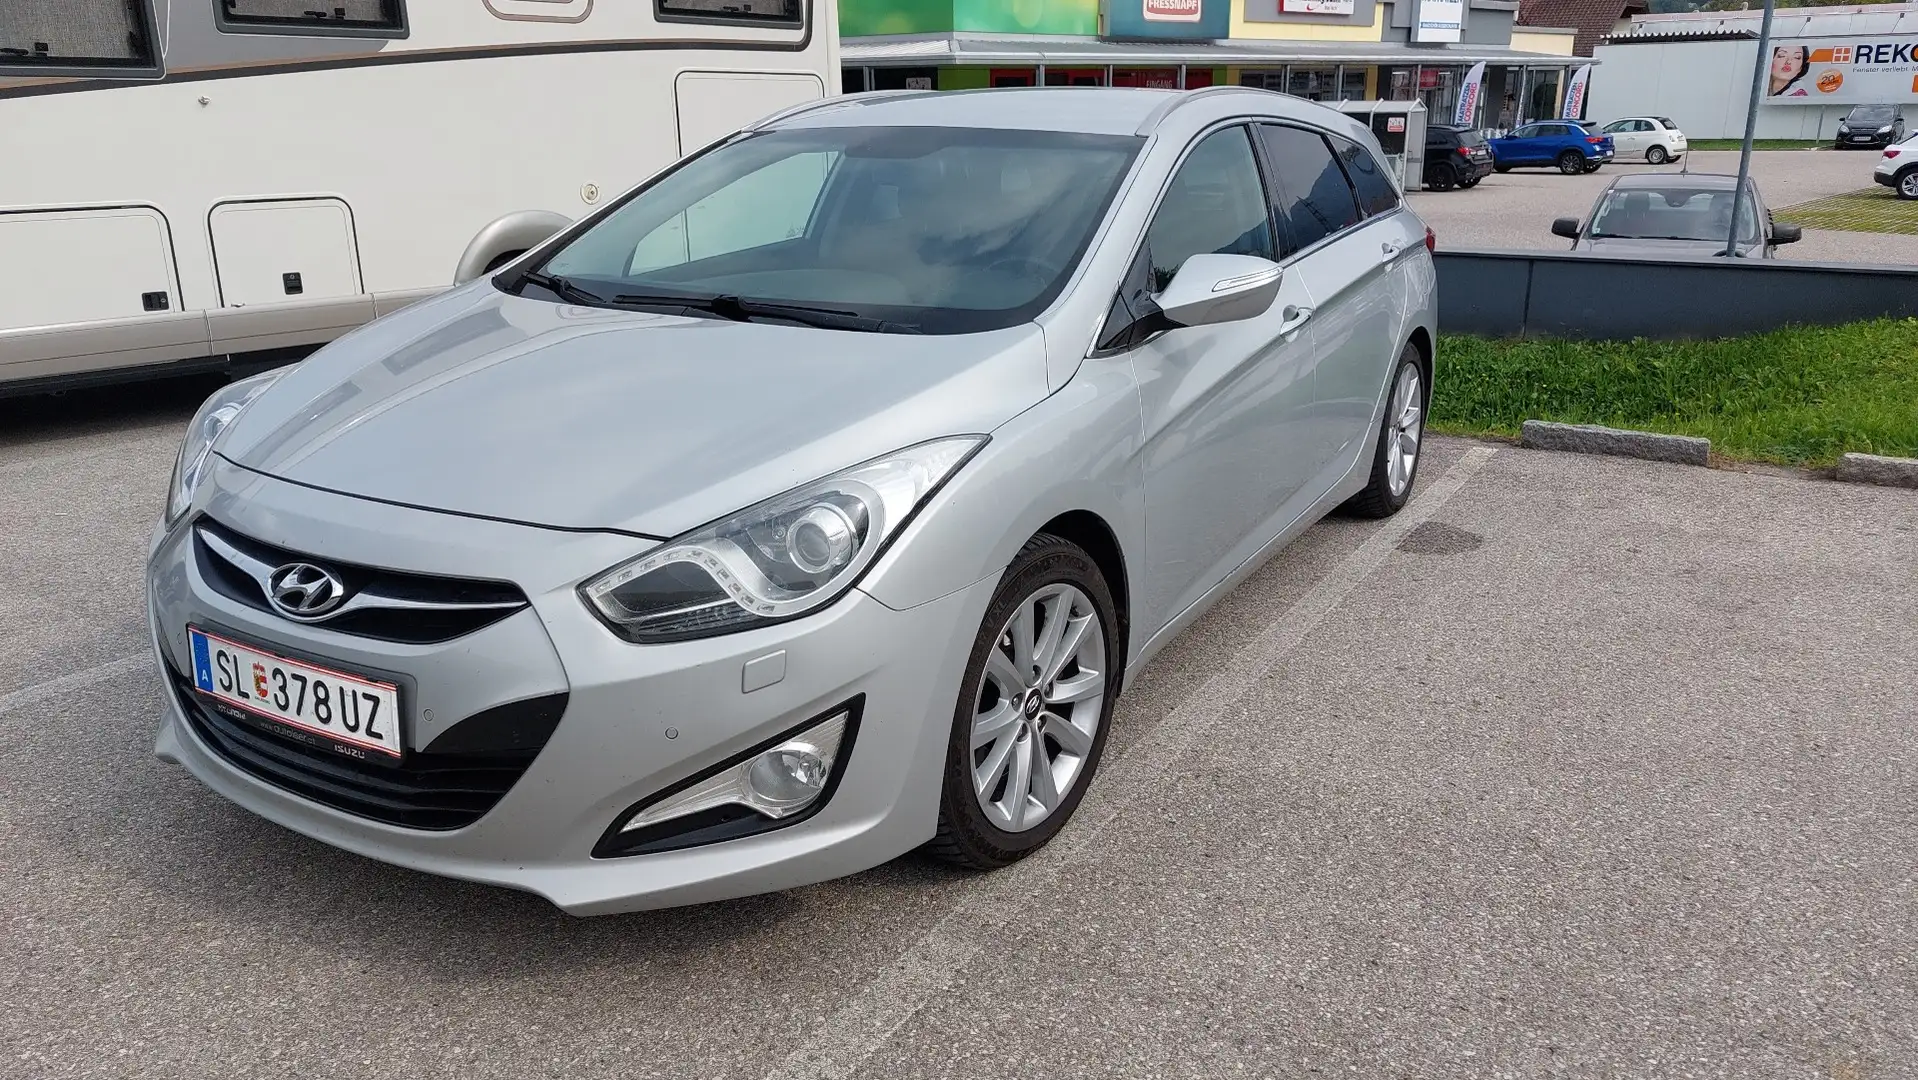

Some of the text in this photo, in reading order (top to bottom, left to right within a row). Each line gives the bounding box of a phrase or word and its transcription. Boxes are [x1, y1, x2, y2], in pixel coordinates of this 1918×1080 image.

[1464, 82, 1478, 122] CONCORD
[1571, 82, 1584, 118] CONCORD
[201, 669, 209, 683] A
[216, 649, 250, 700] SL
[334, 744, 365, 759] ISUZU
